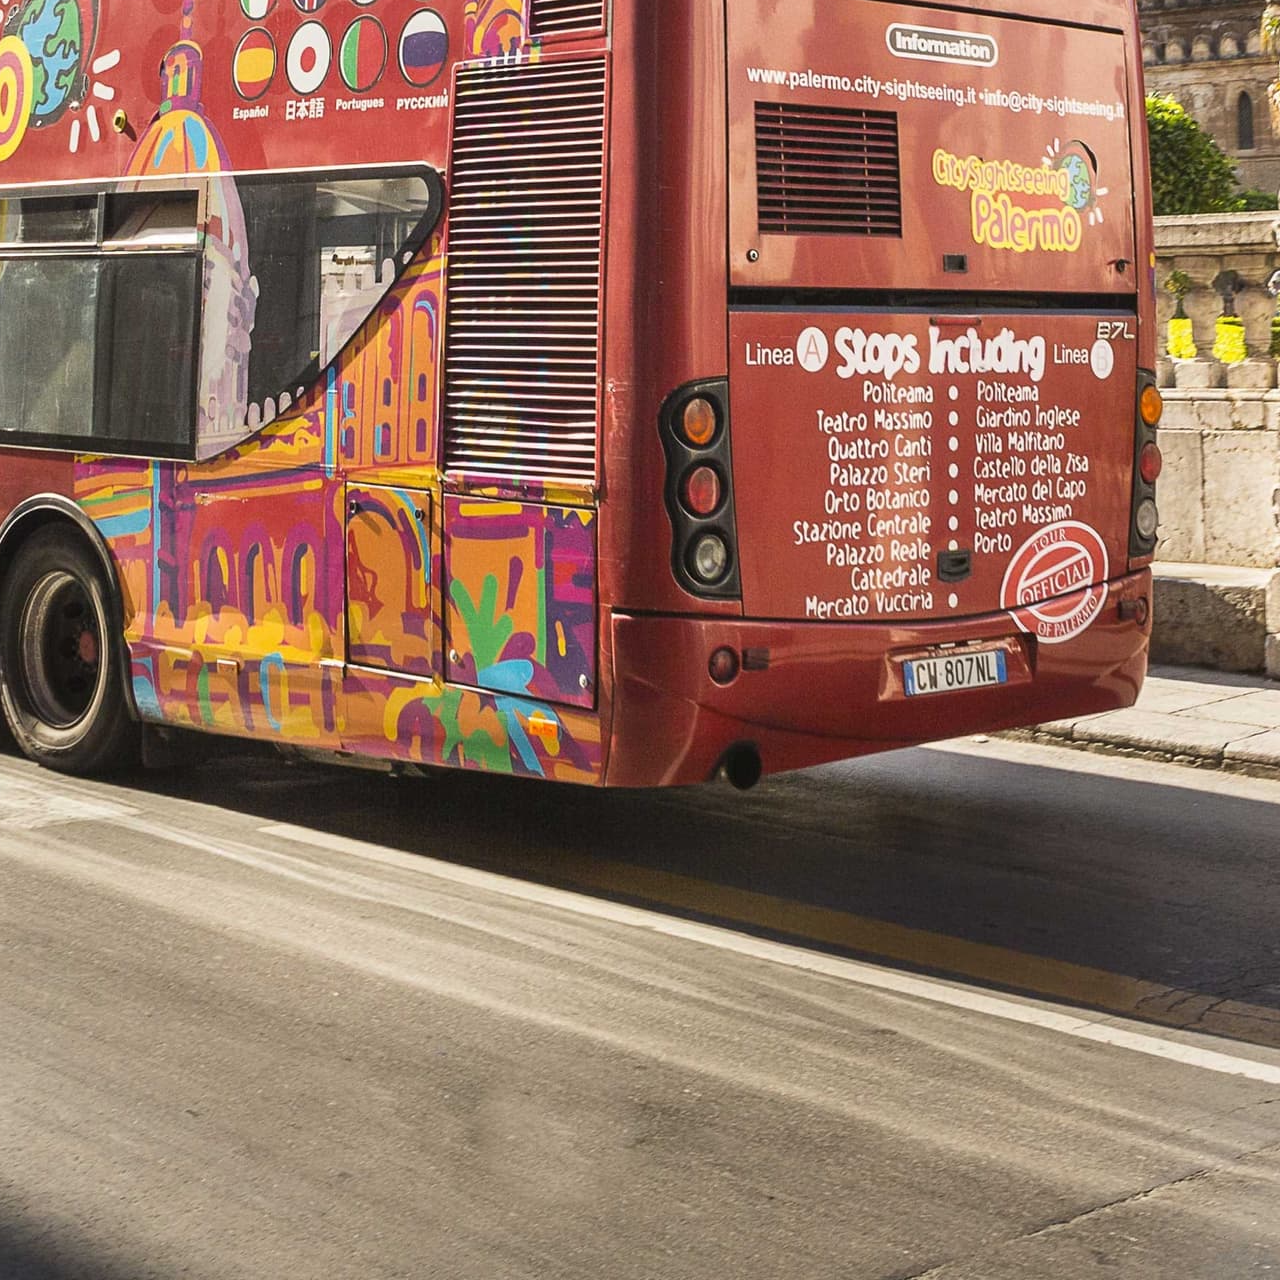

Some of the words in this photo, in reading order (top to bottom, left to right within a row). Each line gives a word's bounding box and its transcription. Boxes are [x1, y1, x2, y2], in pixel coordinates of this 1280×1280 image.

[895, 31, 991, 60] Information
[747, 67, 977, 105] www.palermo.city-sightseeing.it
[984, 90, 1126, 119] info@city-sightseeing.it
[233, 105, 269, 120] Español
[285, 97, 325, 120] 日本語
[970, 189, 1082, 252] Palermo
[1096, 321, 1135, 339] B7L
[745, 342, 794, 366] Linea
[834, 326, 921, 380] Stops
[928, 326, 1046, 382] Including
[1053, 343, 1089, 364] Linea
[863, 380, 934, 404] Politeama
[977, 380, 1039, 403] Politeama
[816, 409, 868, 435] Teatro
[874, 408, 933, 431] Massimo
[976, 405, 1031, 428] Giardino
[1035, 404, 1081, 431] Inglese
[828, 436, 889, 462] Quattro
[894, 433, 932, 457] Canti
[975, 432, 1003, 454] Villa
[1007, 430, 1065, 452] Malfitano
[830, 462, 888, 487] Palazzo
[894, 461, 931, 485] Steri
[973, 456, 1026, 479] Castello
[1030, 453, 1062, 477] della
[1064, 452, 1089, 474] Zisa
[824, 489, 860, 514] Orto
[866, 487, 930, 511] Botanico
[974, 483, 1027, 505] Mercato
[1032, 479, 1053, 501] del
[1056, 476, 1086, 500] Capo
[793, 520, 861, 545] Stazione
[867, 512, 931, 537] Centrale
[974, 507, 1017, 530] Teatro
[826, 543, 884, 567] Palazzo
[890, 538, 931, 562] Reale
[974, 531, 1012, 554] Porto
[1032, 528, 1066, 554] TOUR
[851, 563, 931, 591] Cattedrale
[1021, 559, 1090, 605] OFFICIAL
[806, 595, 869, 619] Mercato
[875, 590, 933, 613] Vucciria
[1037, 621, 1054, 637] OF
[1054, 595, 1098, 636] PALERMO
[916, 662, 938, 691] CW
[944, 655, 996, 687] 807NL
